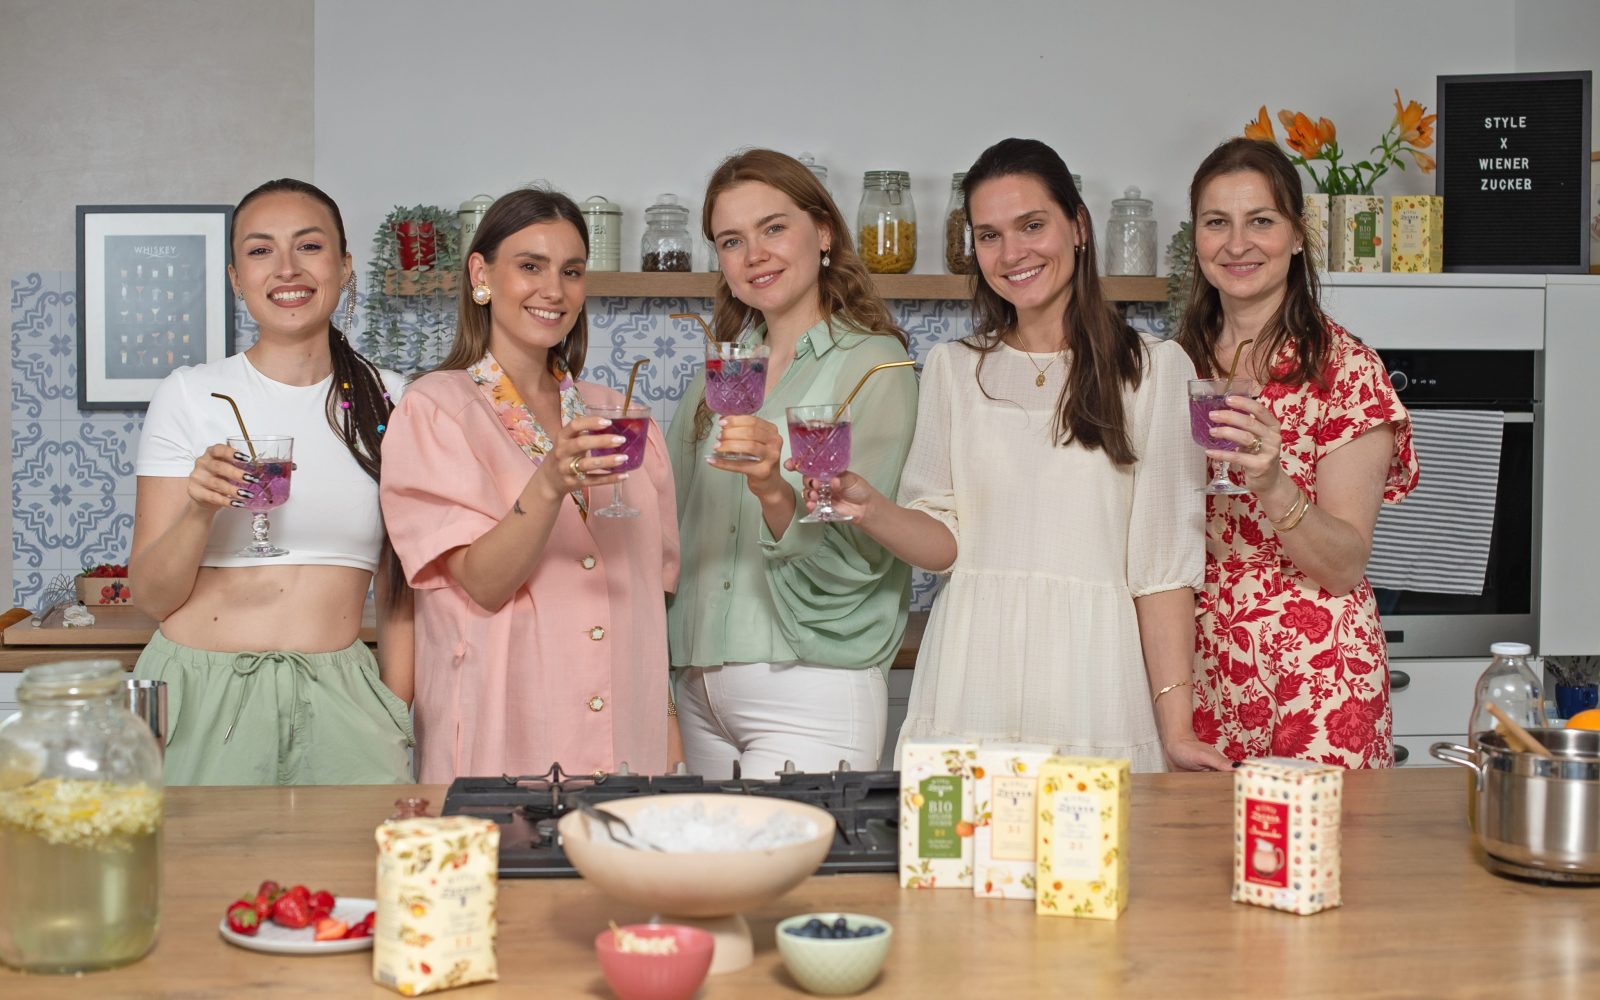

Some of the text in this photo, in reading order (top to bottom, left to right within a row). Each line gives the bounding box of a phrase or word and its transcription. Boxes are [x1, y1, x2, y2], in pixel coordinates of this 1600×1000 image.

[1484, 116, 1527, 129] STYLE
[1500, 137, 1508, 149] X
[1479, 157, 1529, 170] WIENER
[1481, 178, 1532, 190] ZUCKER
[134, 246, 176, 255] WHISKEY
[928, 800, 953, 814] BIO
